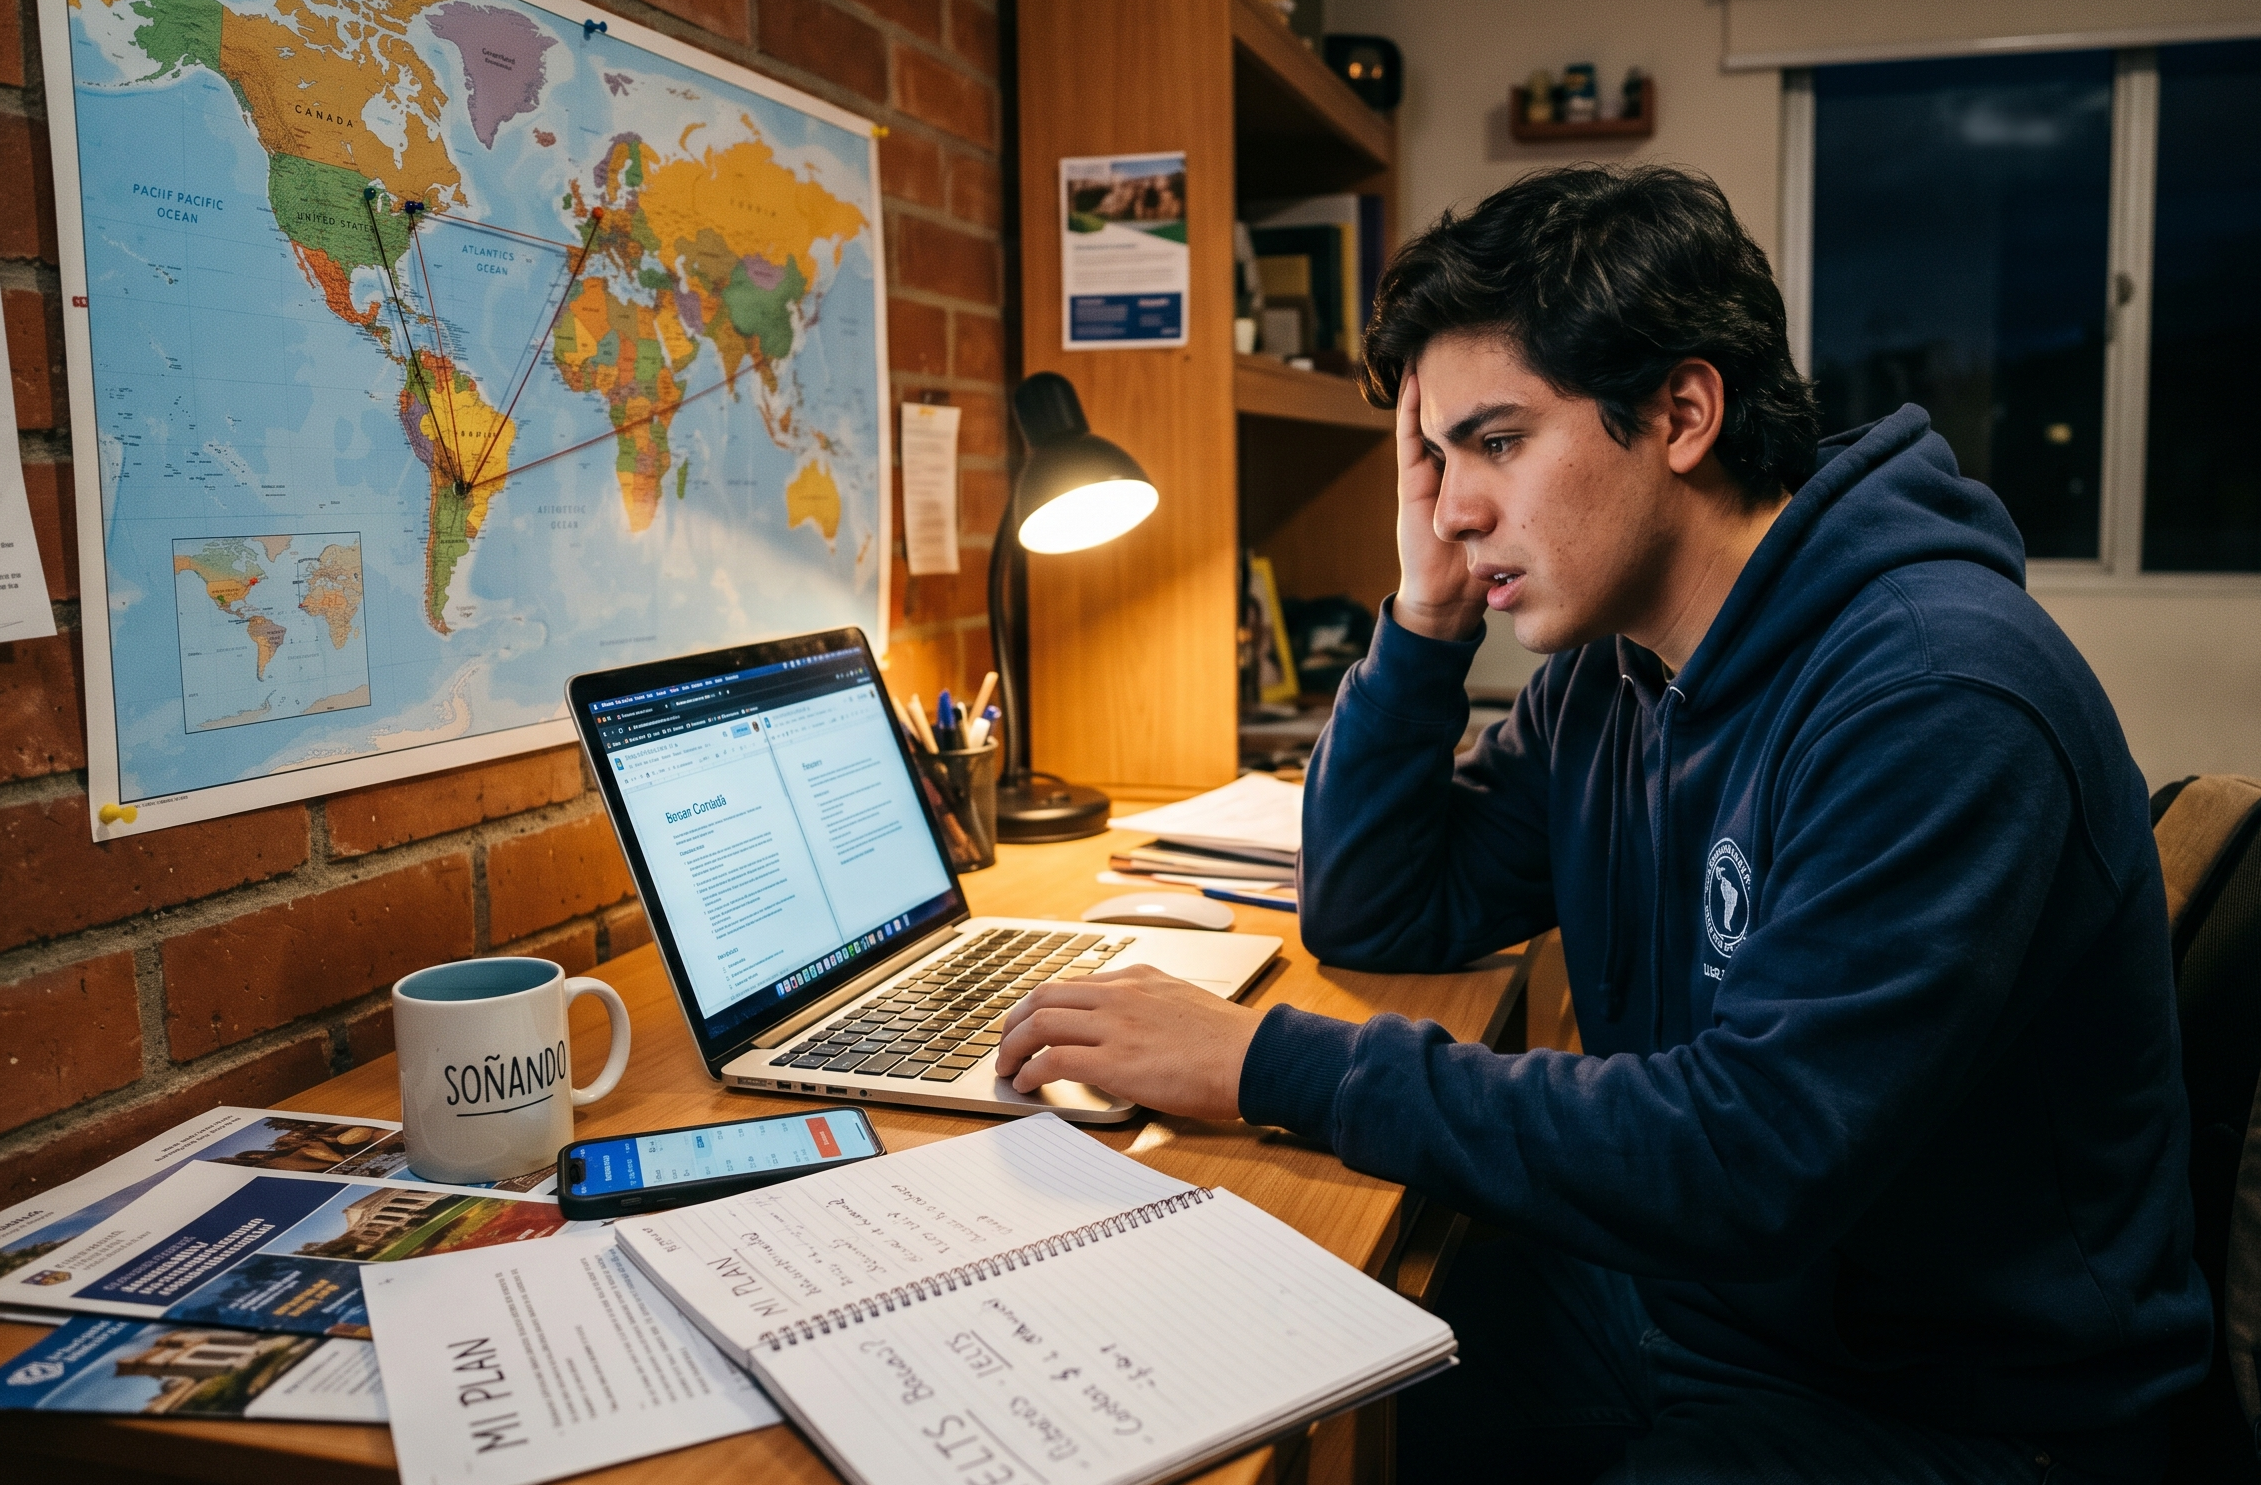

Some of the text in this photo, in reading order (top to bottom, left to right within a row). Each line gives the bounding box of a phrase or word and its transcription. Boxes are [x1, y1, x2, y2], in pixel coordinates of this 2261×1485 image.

[295, 104, 353, 128] CANADA
[177, 192, 224, 211] PACIFIC
[157, 207, 198, 224] OCEAN
[297, 211, 336, 226] UNITED
[461, 244, 515, 262] ATLANTICS
[444, 1039, 567, 1107] SOÑANDO
[706, 1256, 763, 1297] PLAN
[748, 1297, 789, 1318] MI
[445, 1336, 531, 1456] MI PLAN
